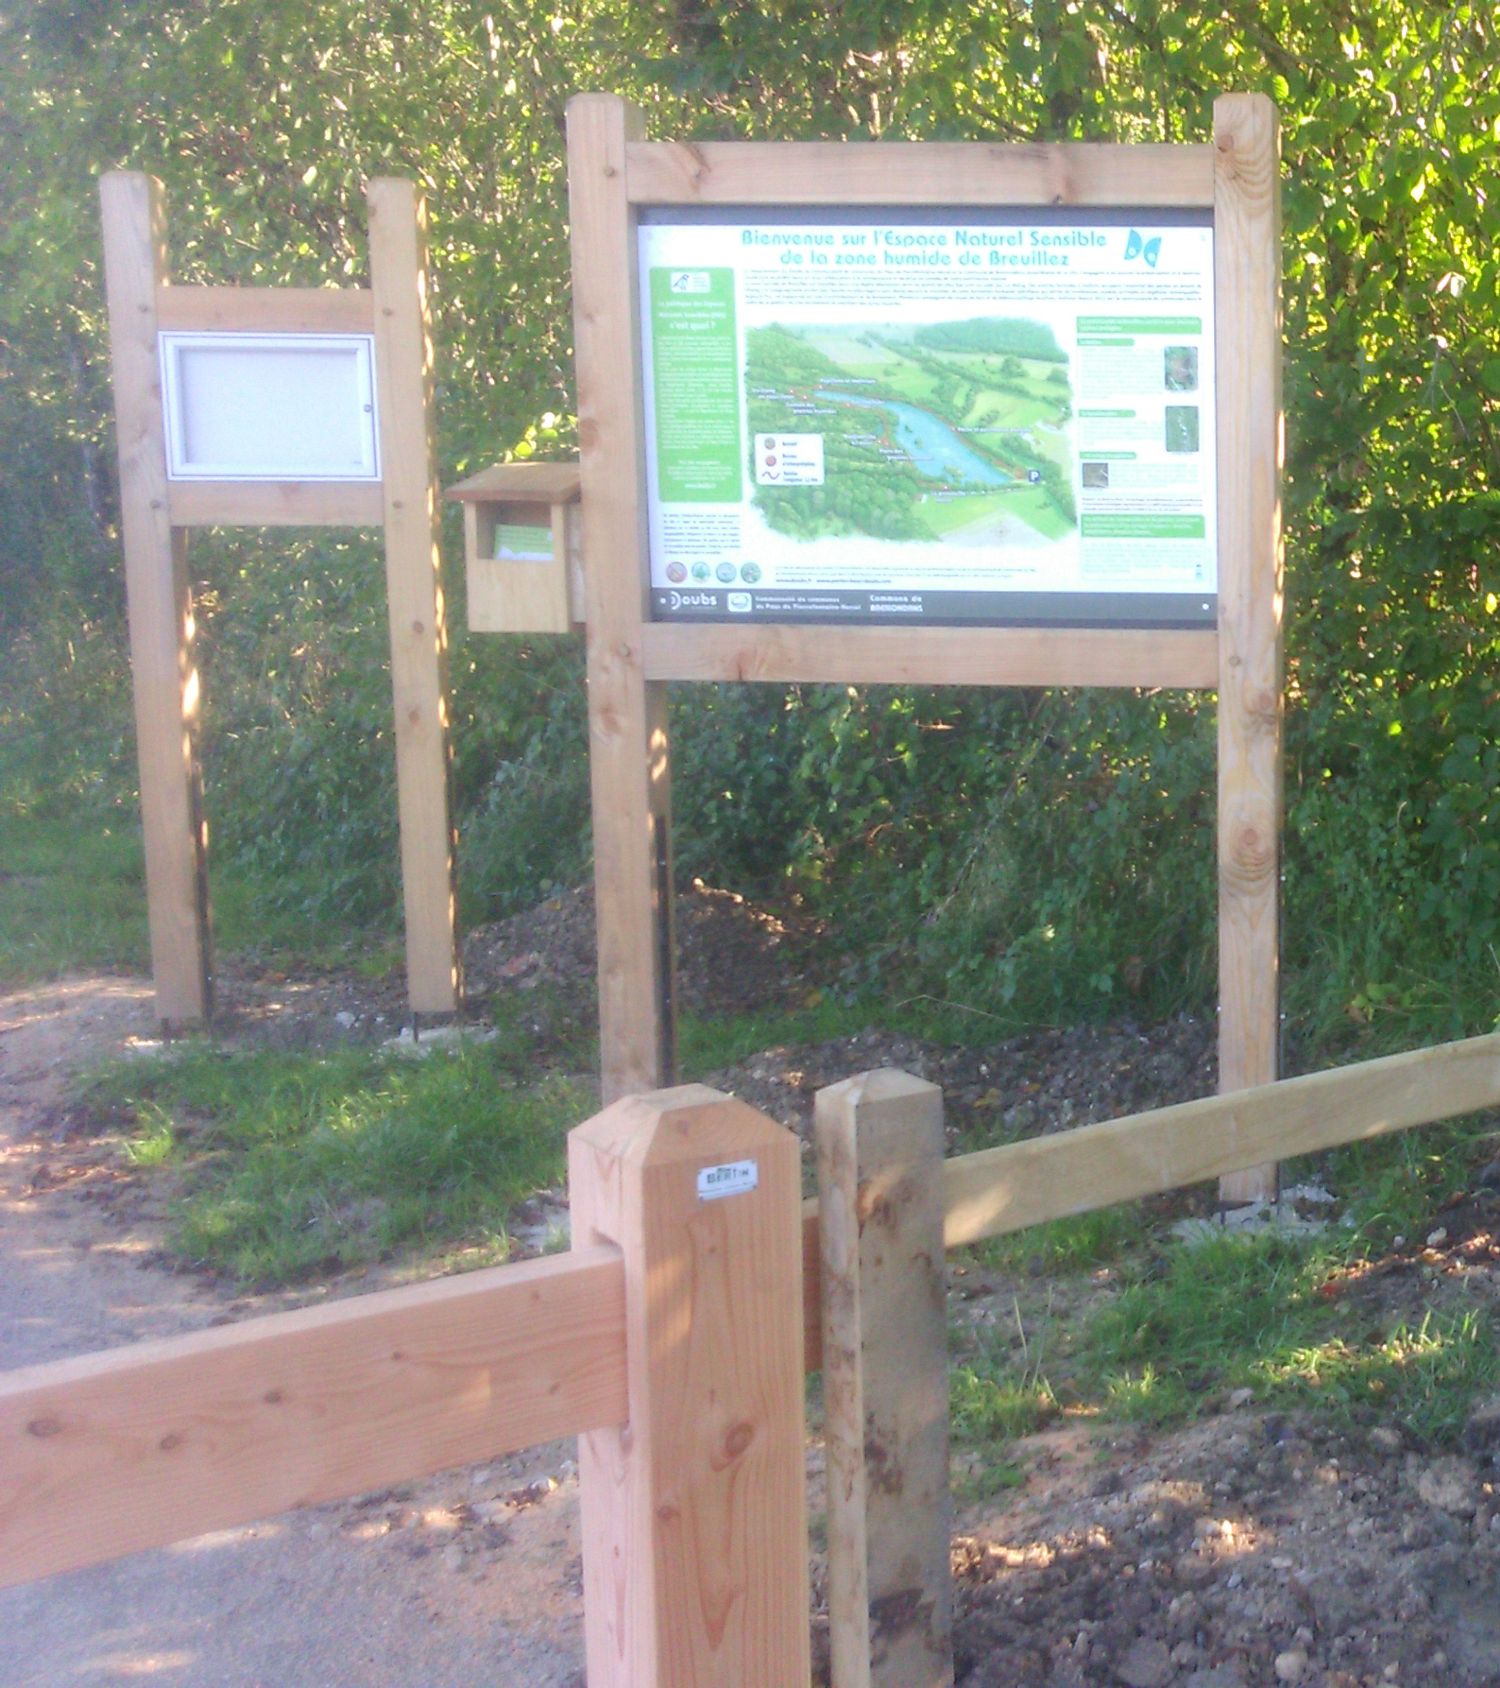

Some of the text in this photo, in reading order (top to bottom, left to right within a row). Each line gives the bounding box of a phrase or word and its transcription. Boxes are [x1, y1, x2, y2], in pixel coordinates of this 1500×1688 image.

[742, 229, 1108, 248] Bienvenue sur l'Espace Naturel Sensible
[780, 249, 1070, 266] de la zone humide de Breuillez
